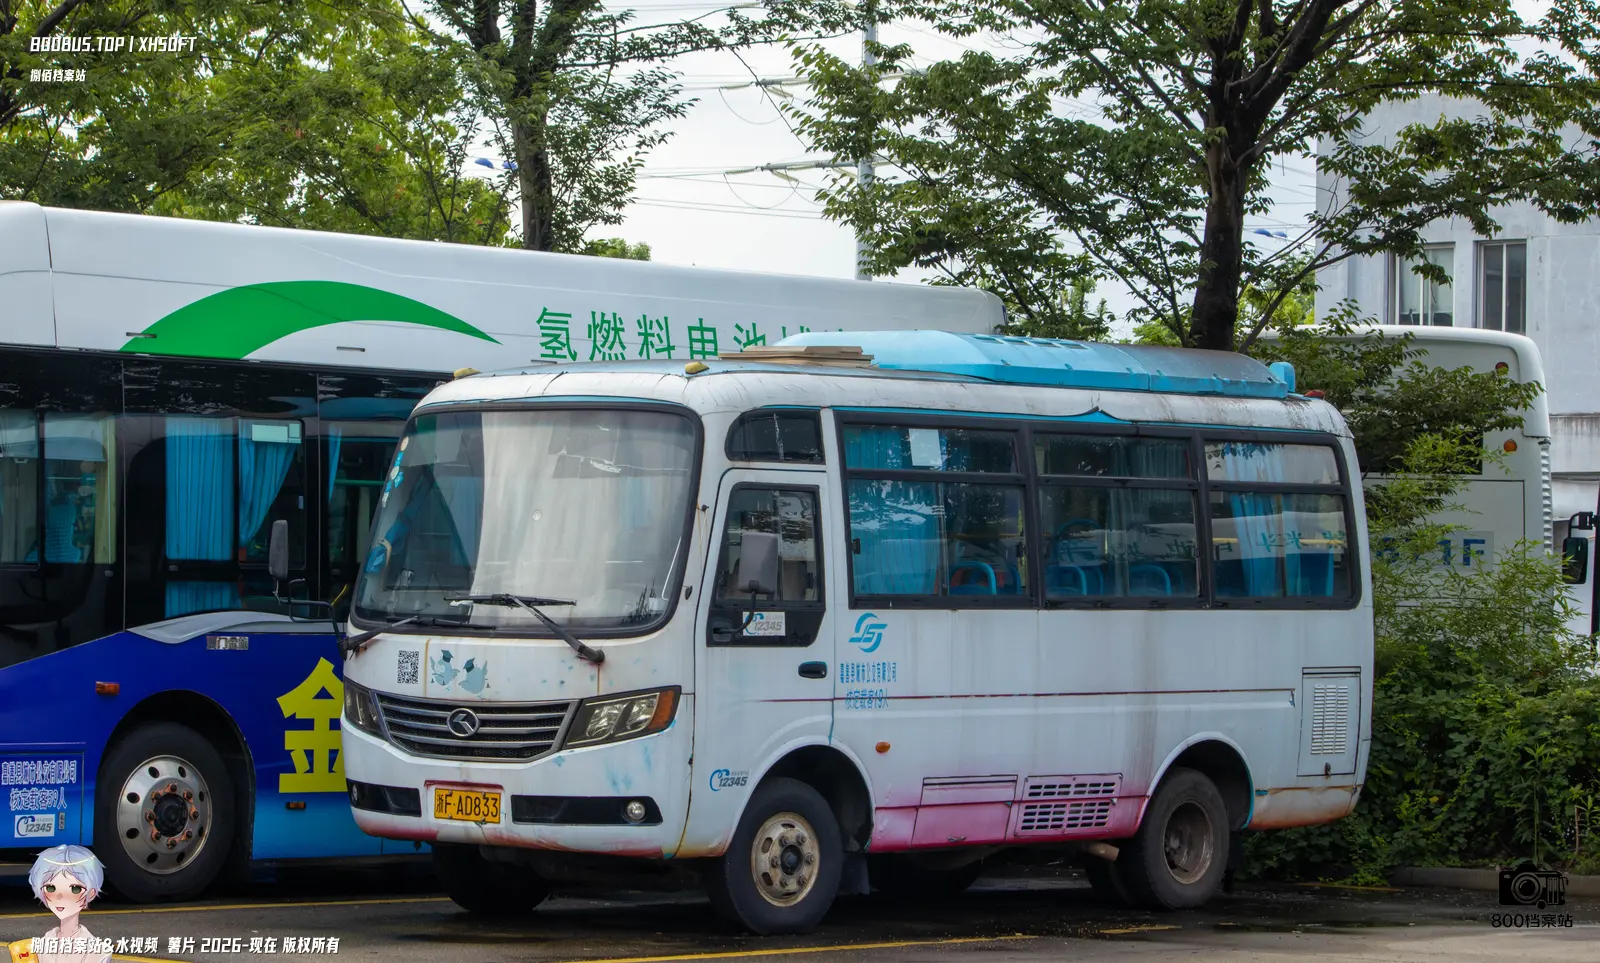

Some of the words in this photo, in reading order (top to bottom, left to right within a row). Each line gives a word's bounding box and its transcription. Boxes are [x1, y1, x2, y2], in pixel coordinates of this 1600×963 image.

[536, 306, 843, 362] 氢燃料电池
[276, 656, 348, 793] 金
[718, 776, 748, 788] 12345
[25, 823, 53, 833] 12345
